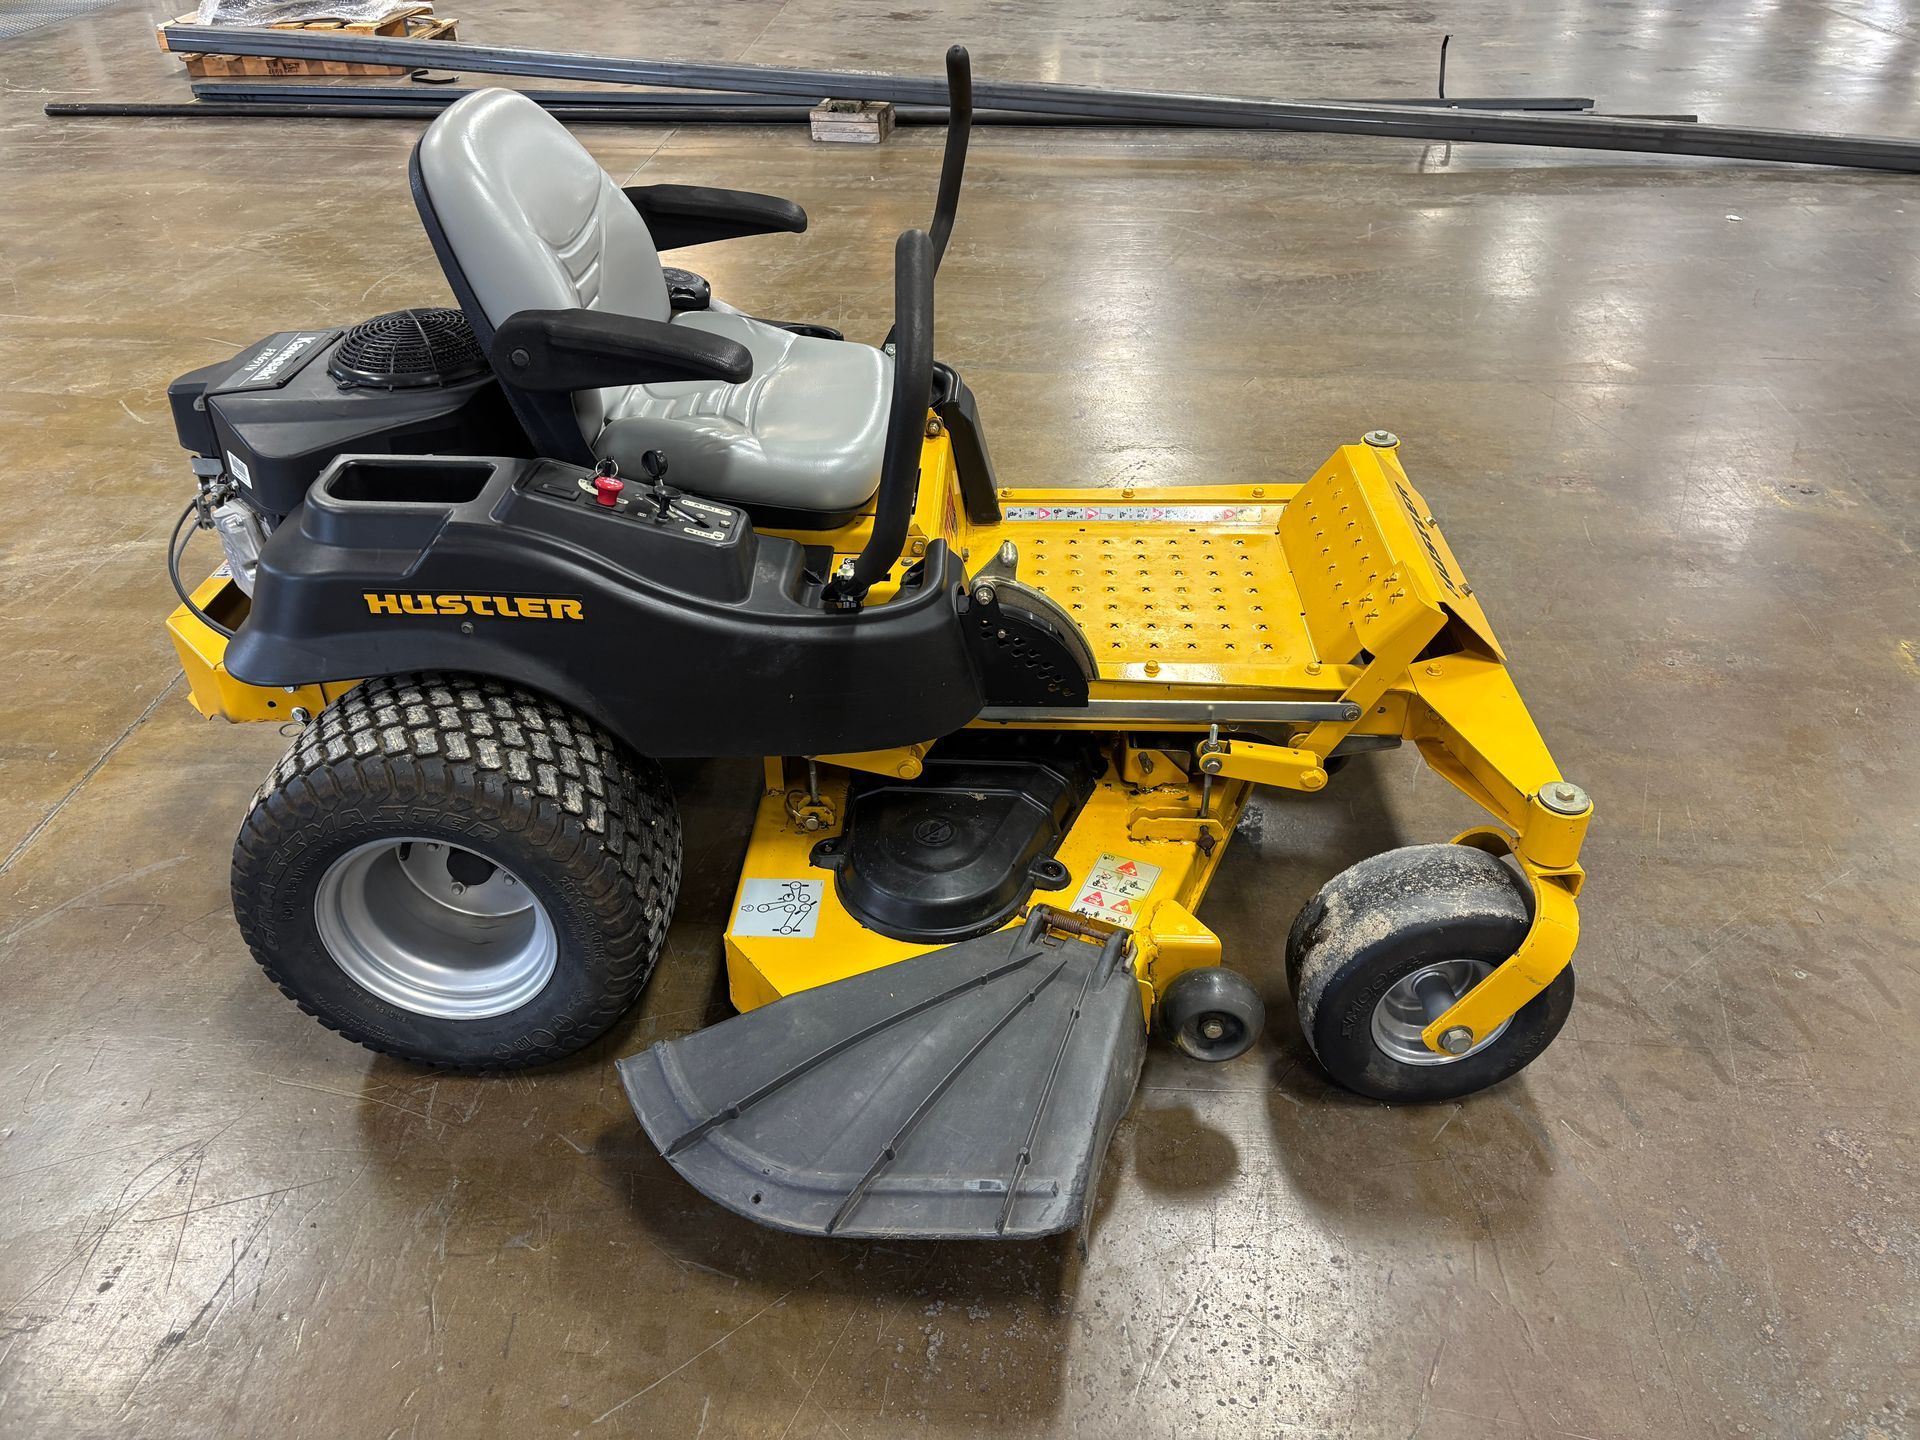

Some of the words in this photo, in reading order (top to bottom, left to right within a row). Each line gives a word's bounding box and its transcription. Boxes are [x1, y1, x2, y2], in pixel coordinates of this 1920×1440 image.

[250, 336, 317, 381] Kawasaki
[1394, 480, 1461, 600] HUSTLER
[363, 593, 584, 620] HUSTLER
